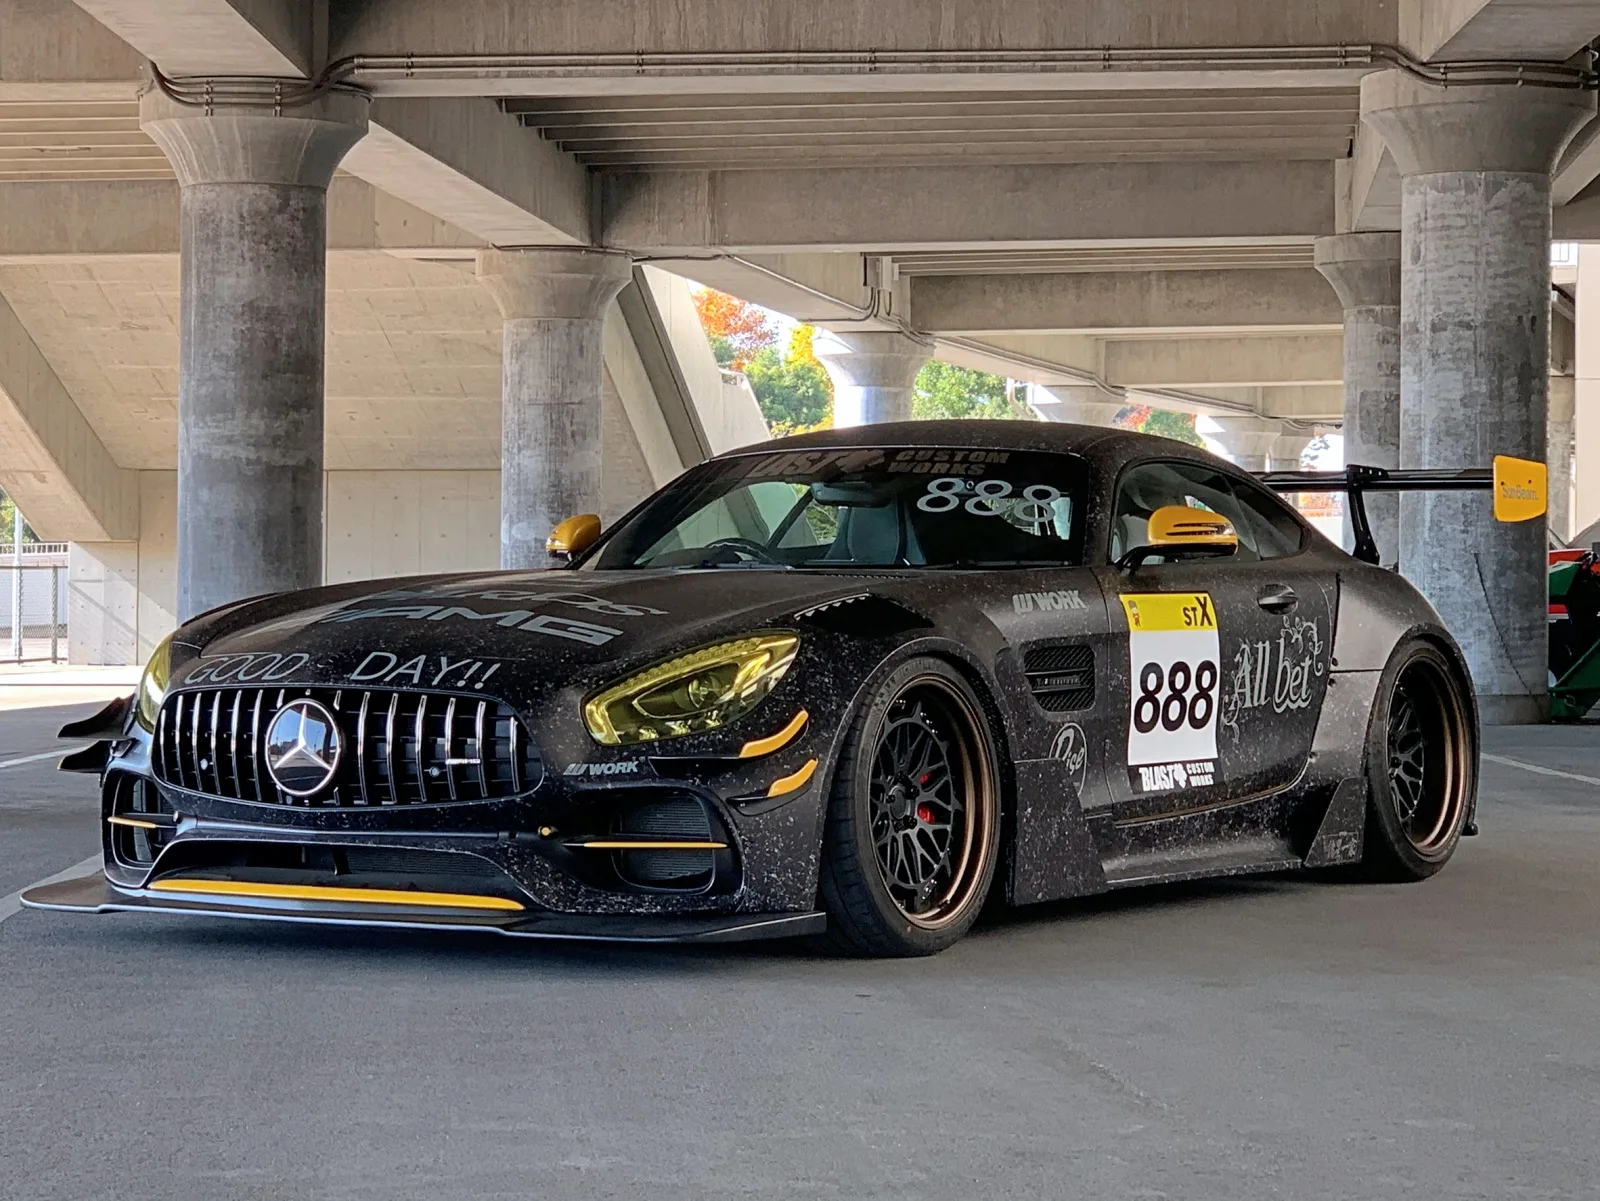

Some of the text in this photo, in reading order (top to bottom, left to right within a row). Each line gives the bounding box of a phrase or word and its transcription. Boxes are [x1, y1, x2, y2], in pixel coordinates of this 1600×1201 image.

[895, 450, 1011, 464] CUSTOM
[888, 462, 985, 475] WORKS
[917, 477, 1060, 523] 888
[1031, 590, 1088, 611] WORK
[335, 605, 624, 646] AMG
[184, 651, 500, 690] GOOD DAY!!
[1134, 660, 1217, 734] 888
[588, 761, 639, 775] WORK
[1139, 765, 1176, 792] BLAST
[1187, 762, 1215, 774] CUSTOM
[1189, 773, 1214, 787] WORKS
